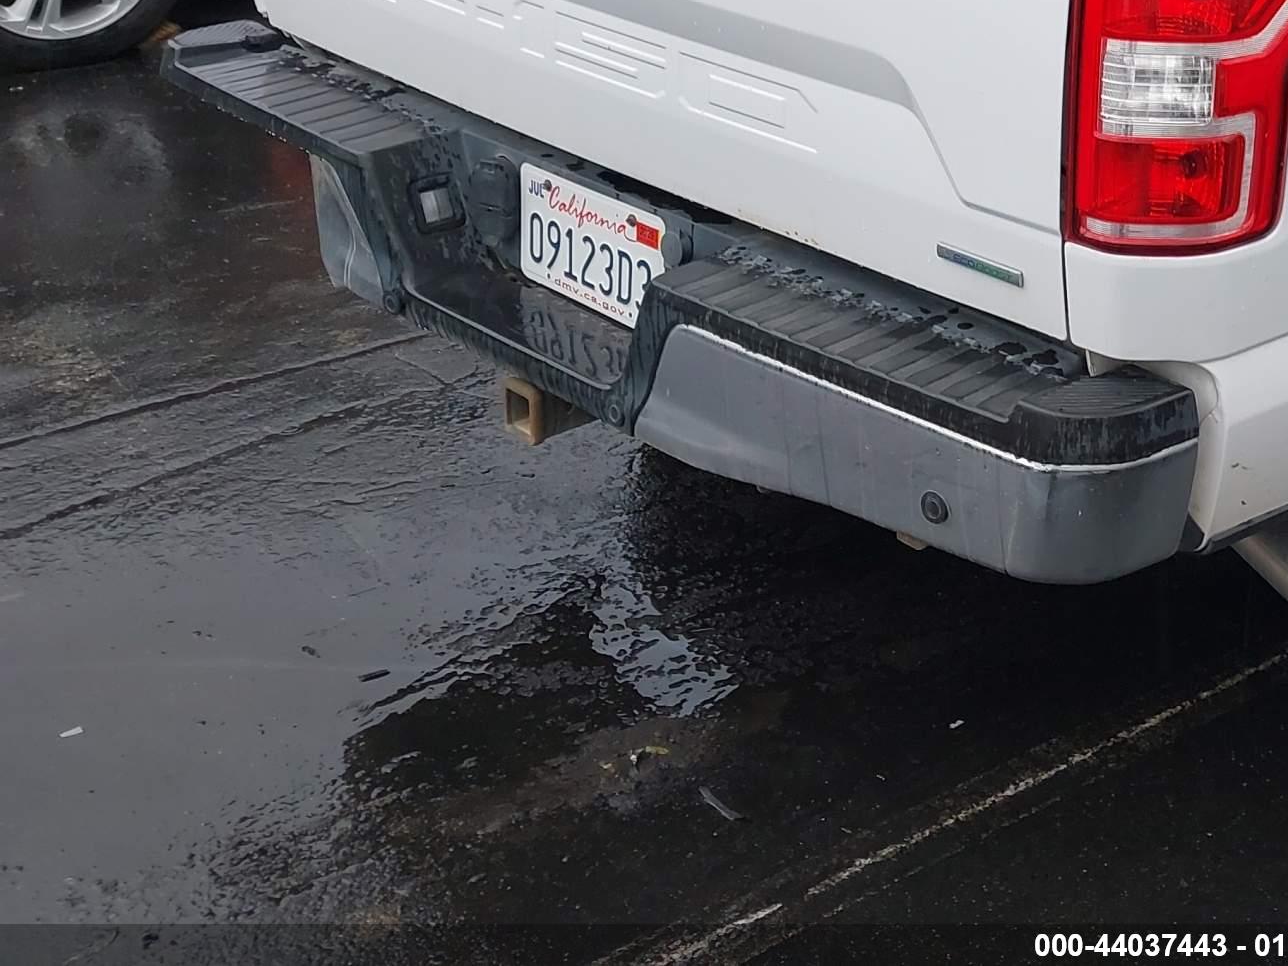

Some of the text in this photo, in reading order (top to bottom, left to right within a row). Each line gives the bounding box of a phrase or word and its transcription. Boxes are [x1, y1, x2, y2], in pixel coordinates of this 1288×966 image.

[549, 185, 637, 243] California
[530, 212, 652, 310] 09123D3
[554, 278, 625, 316] dmv.ca.gov
